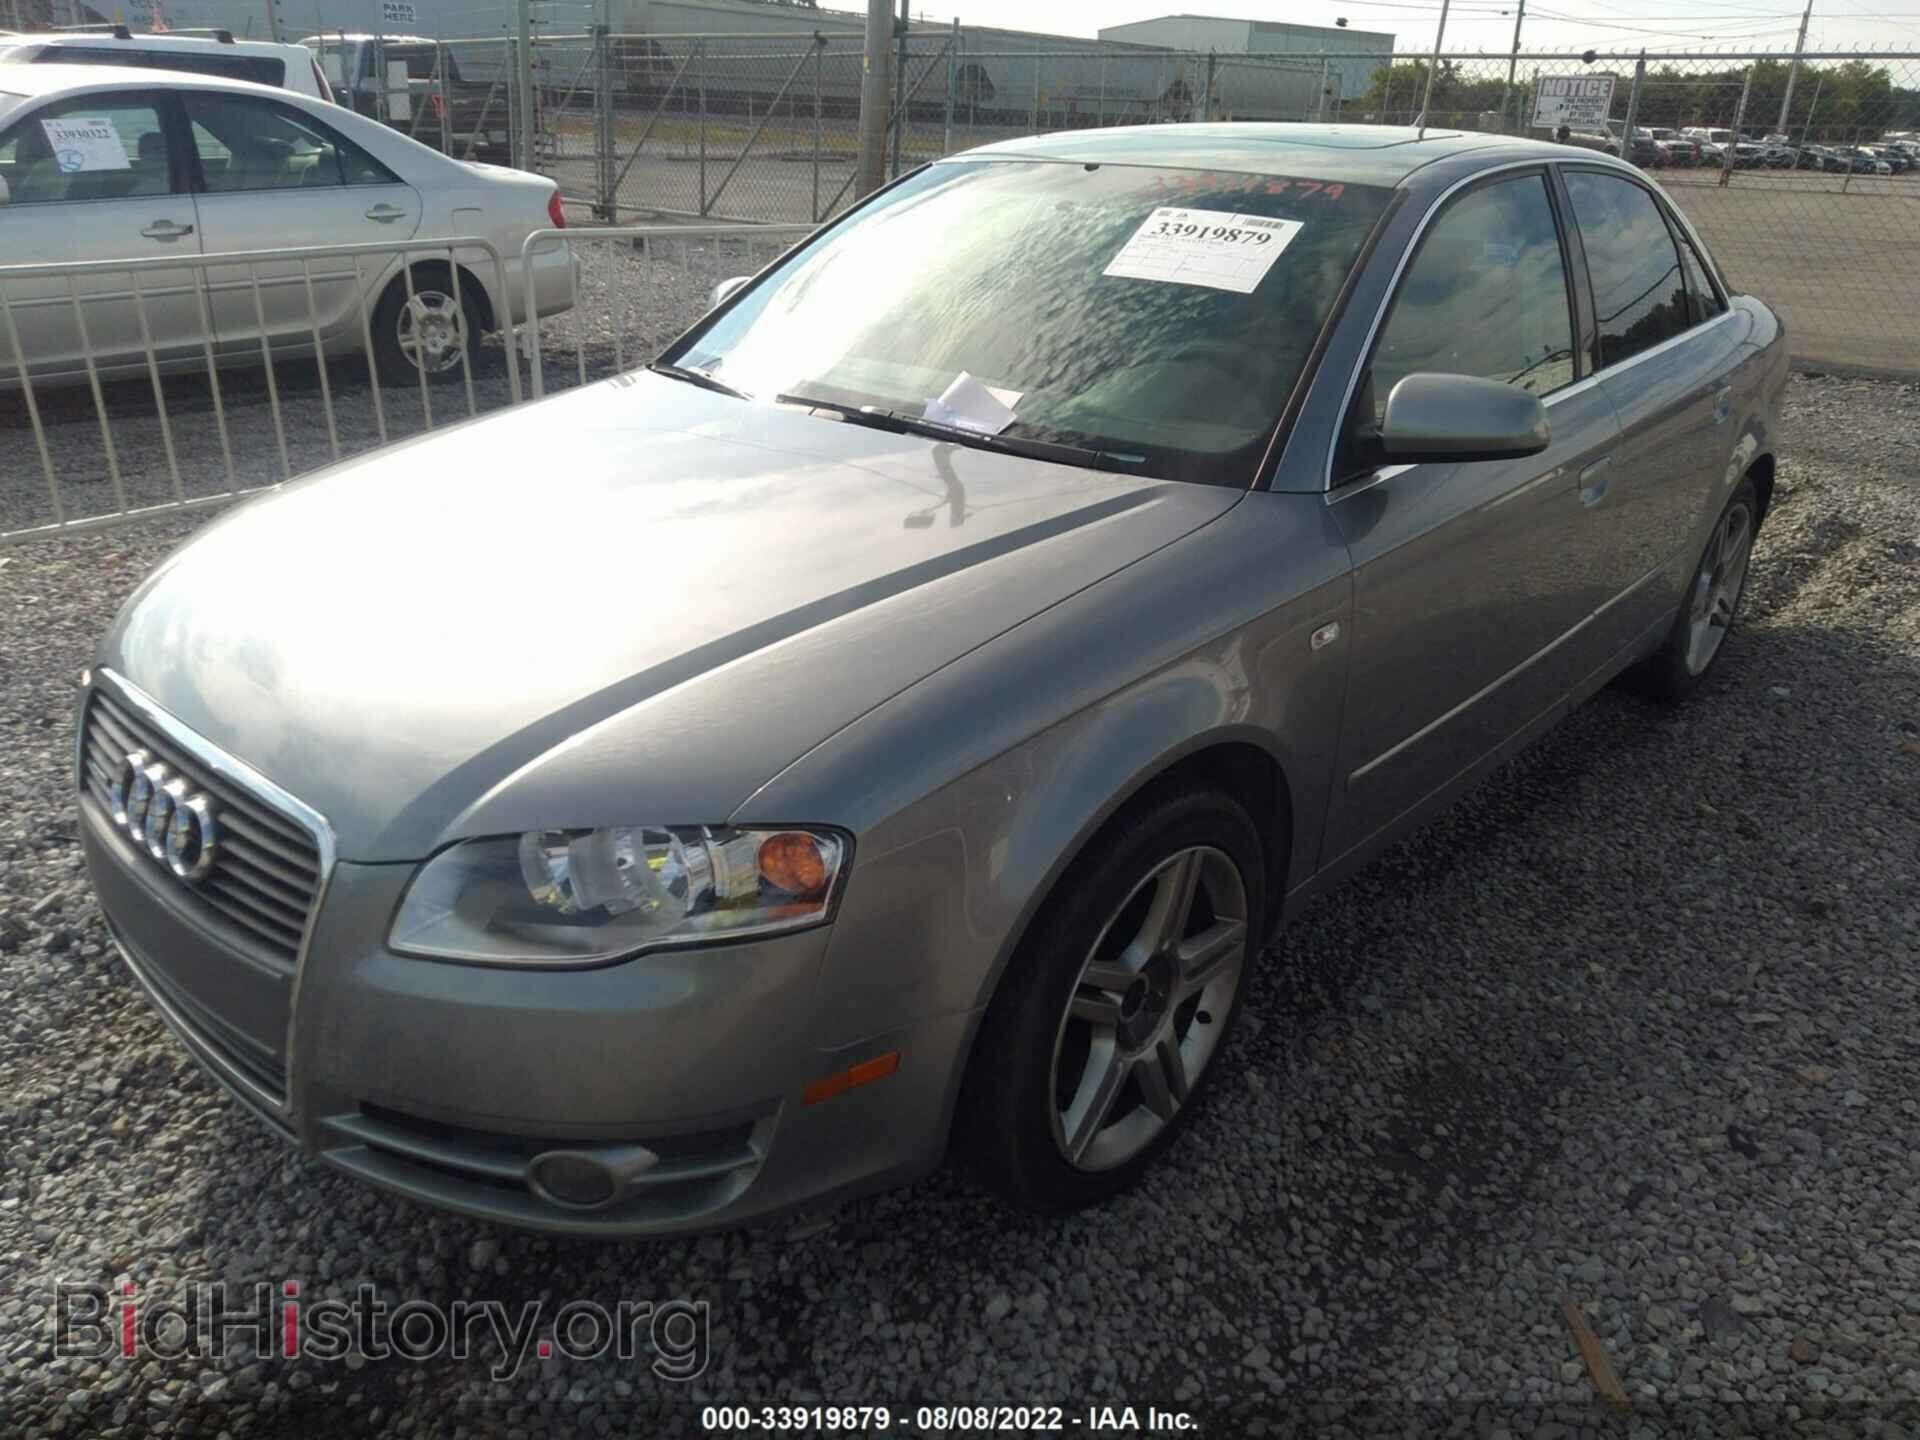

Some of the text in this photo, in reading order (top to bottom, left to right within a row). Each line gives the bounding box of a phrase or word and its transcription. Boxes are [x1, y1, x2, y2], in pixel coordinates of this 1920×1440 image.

[384, 3, 414, 13] PARK
[1541, 79, 1611, 96] NOTICE
[1151, 221, 1272, 246] 33919879
